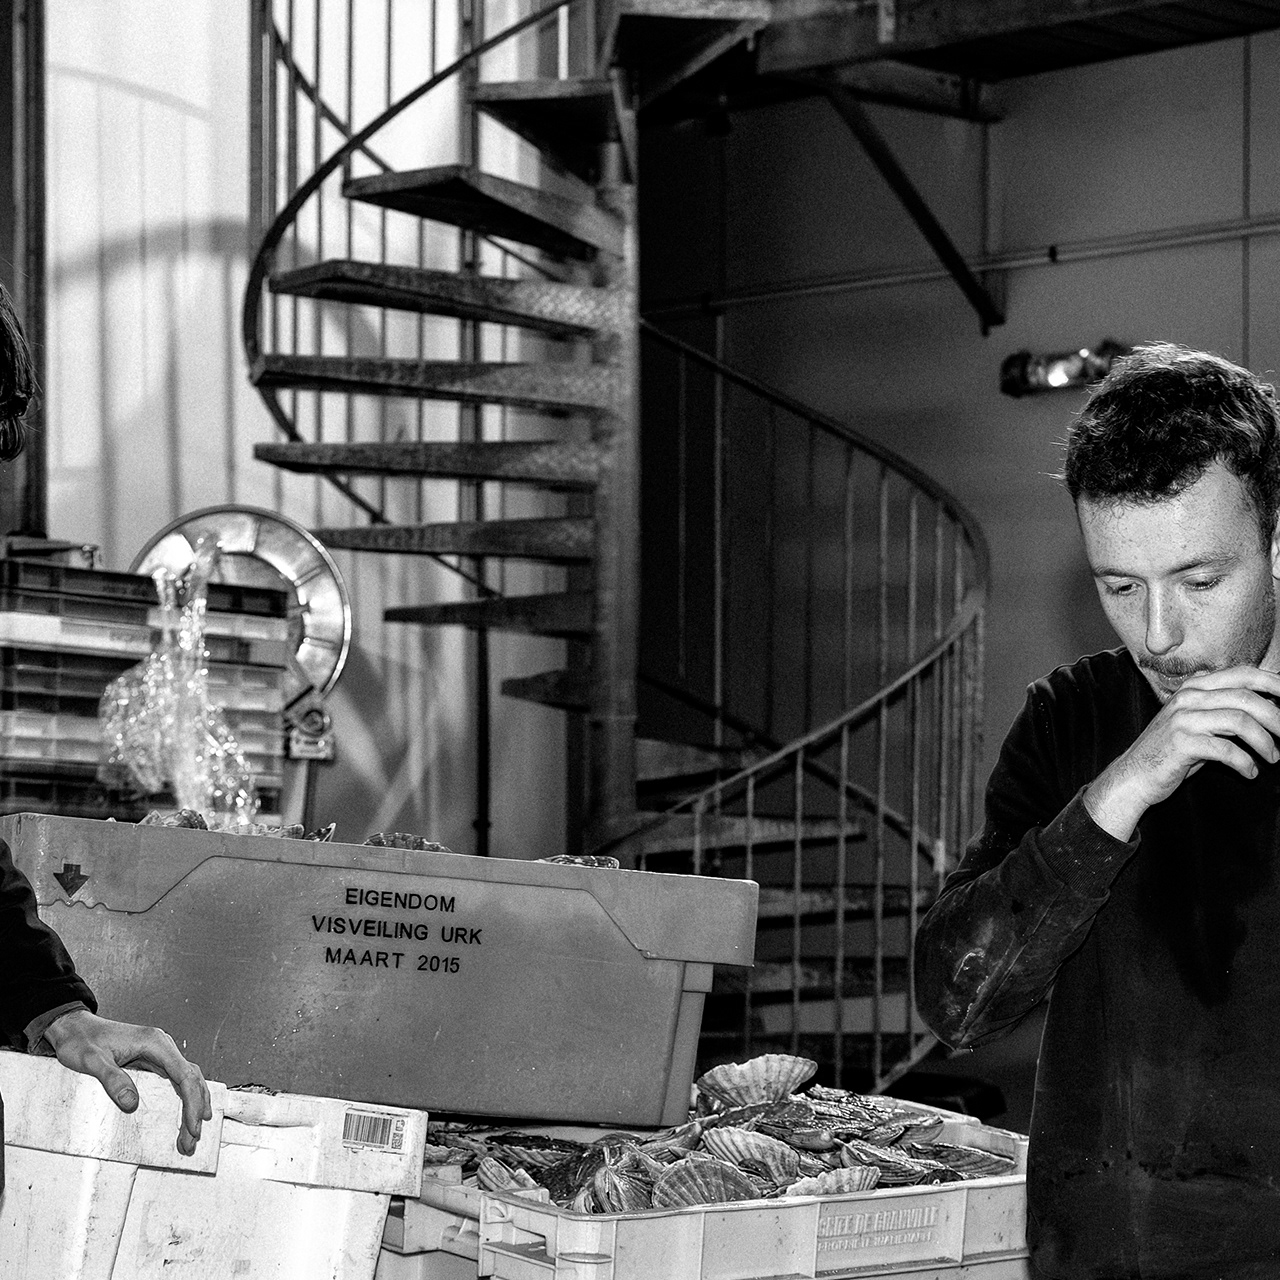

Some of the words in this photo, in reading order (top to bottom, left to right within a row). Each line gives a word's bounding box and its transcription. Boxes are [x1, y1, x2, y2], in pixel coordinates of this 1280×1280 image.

[345, 888, 455, 913] EIGENDOM
[312, 915, 429, 940] VISVEILING
[441, 926, 482, 944] URK
[325, 947, 405, 969] MAART
[417, 955, 460, 973] 2015
